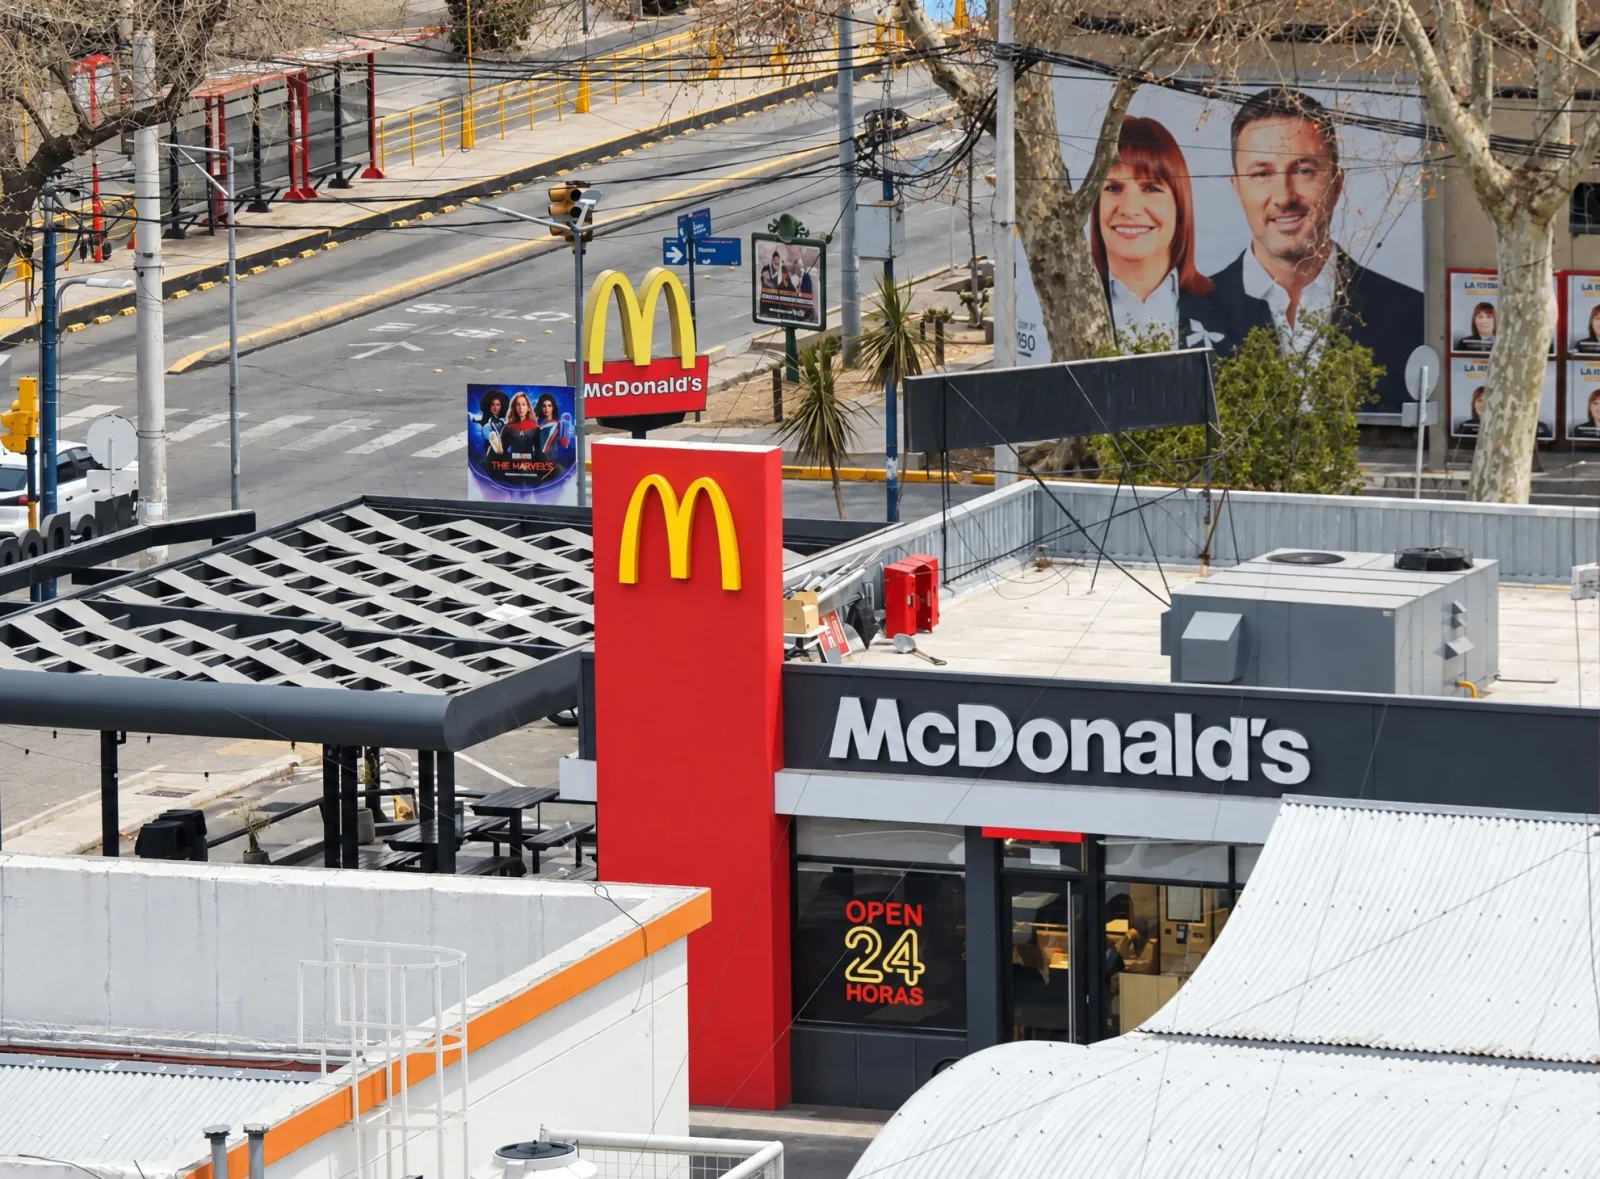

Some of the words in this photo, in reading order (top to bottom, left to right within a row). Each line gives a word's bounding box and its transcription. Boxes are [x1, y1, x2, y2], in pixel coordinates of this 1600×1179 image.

[583, 376, 703, 399] McDonald's
[491, 460, 510, 470] THE
[512, 461, 554, 471] MARVELS
[828, 695, 1312, 786] McDonald's
[845, 899, 923, 928] OPEN
[845, 925, 926, 987] 24
[846, 983, 924, 1007] HORAS
